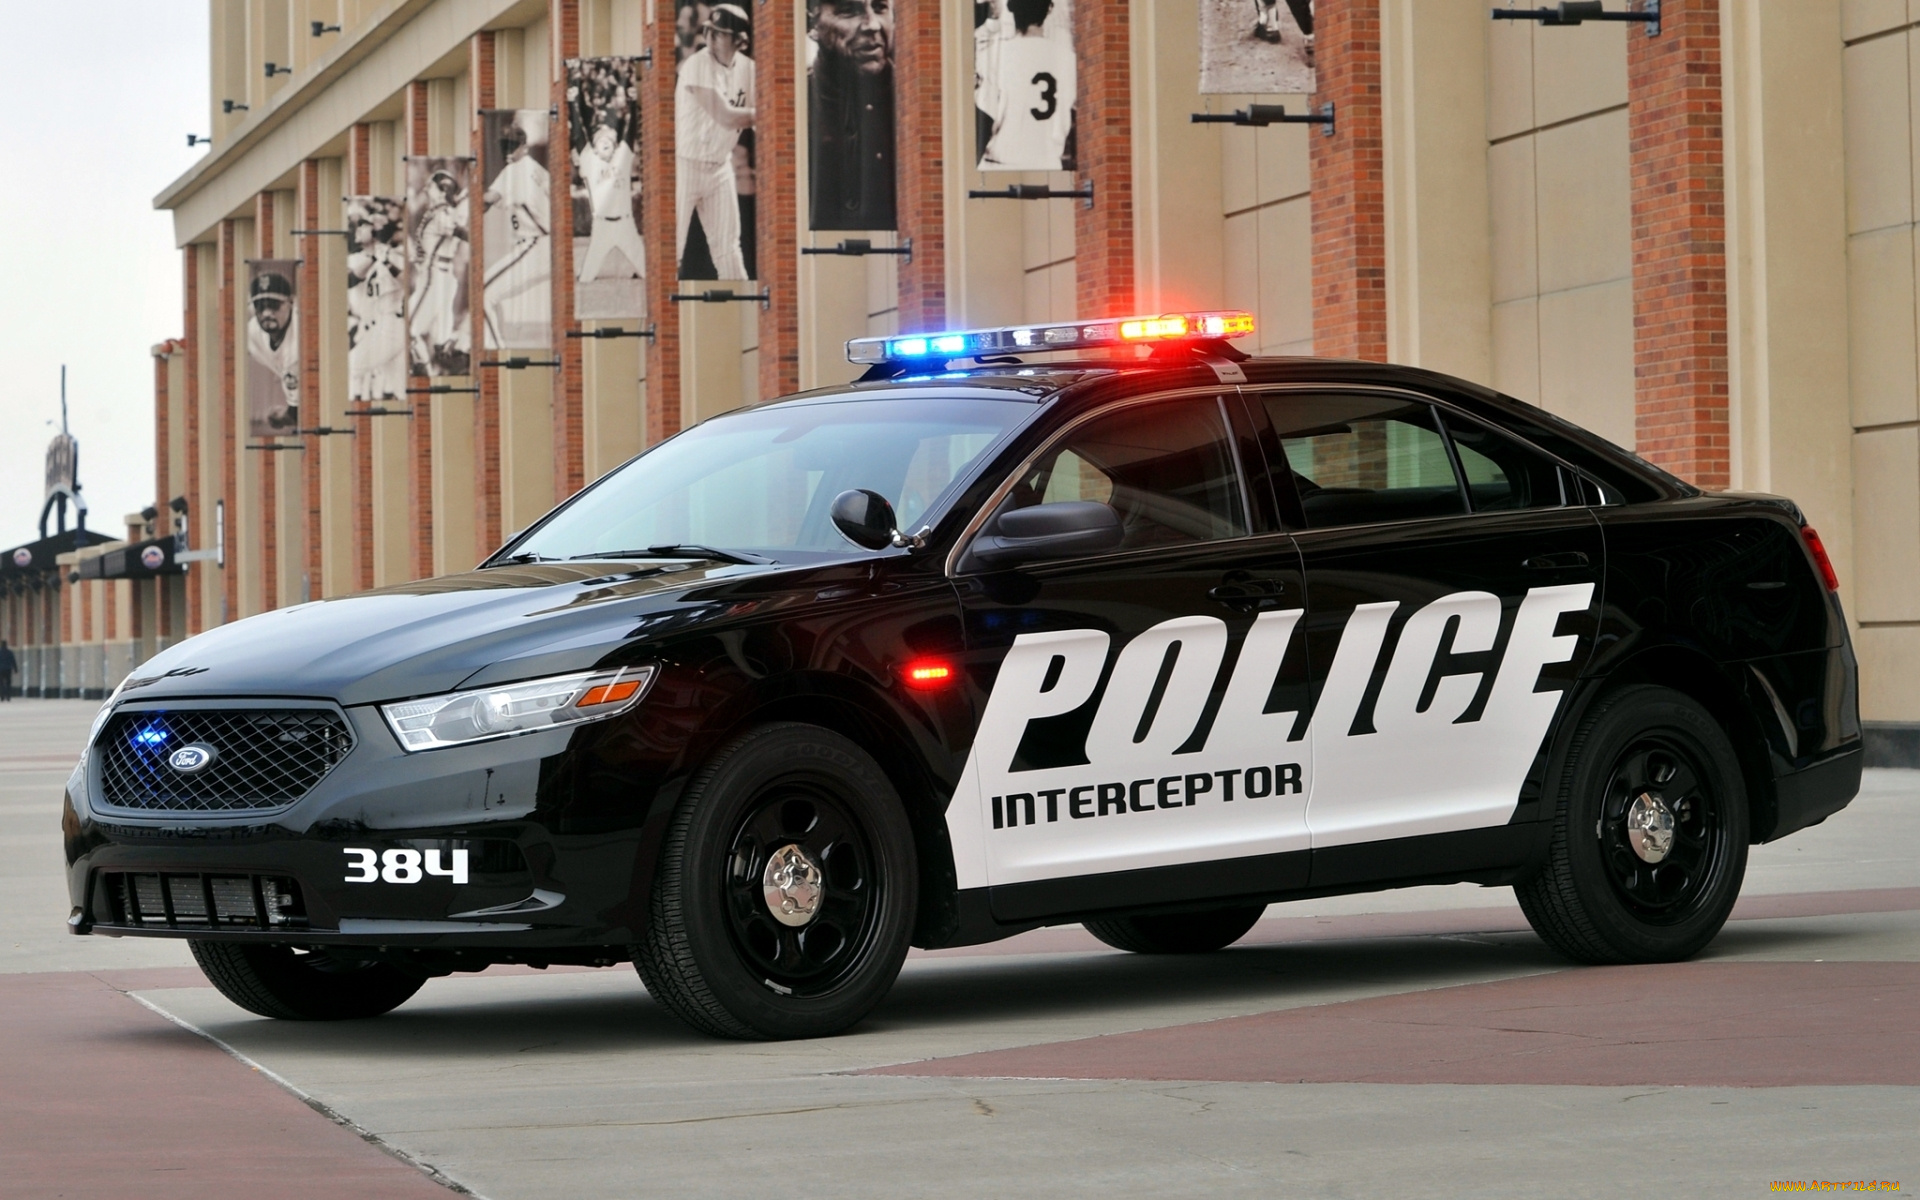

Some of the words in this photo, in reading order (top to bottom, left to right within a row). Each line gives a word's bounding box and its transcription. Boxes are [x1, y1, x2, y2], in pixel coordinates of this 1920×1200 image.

[1030, 72, 1057, 121] 3
[511, 214, 520, 231] 6
[966, 582, 1596, 774] POLICE
[175, 751, 198, 766] Ford
[991, 762, 1303, 830] INTERCEPTOR
[343, 847, 469, 884] 384
